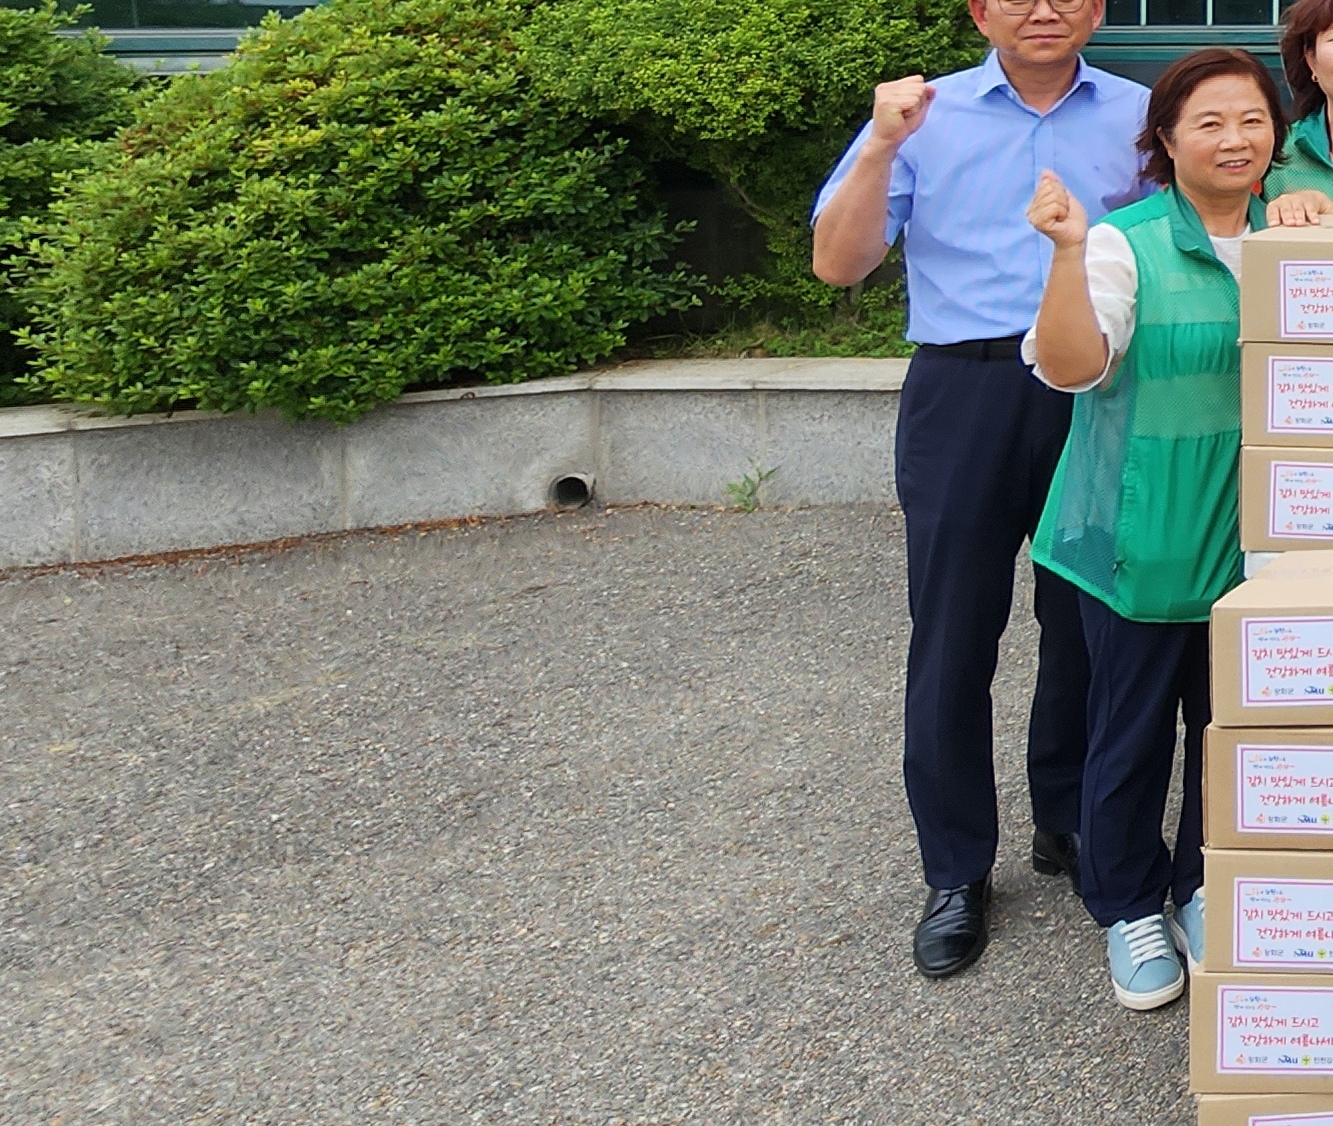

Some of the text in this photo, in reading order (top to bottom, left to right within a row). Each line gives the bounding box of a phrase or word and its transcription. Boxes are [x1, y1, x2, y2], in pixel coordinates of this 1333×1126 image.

[1289, 287, 1306, 298] 김치
[1252, 647, 1272, 660] 김치
[1276, 646, 1312, 660] 맛있게
[1265, 665, 1312, 678] 건강하게
[1247, 775, 1266, 787] 김치
[1270, 775, 1305, 788] 맛있게
[1259, 793, 1305, 806] 건강하게
